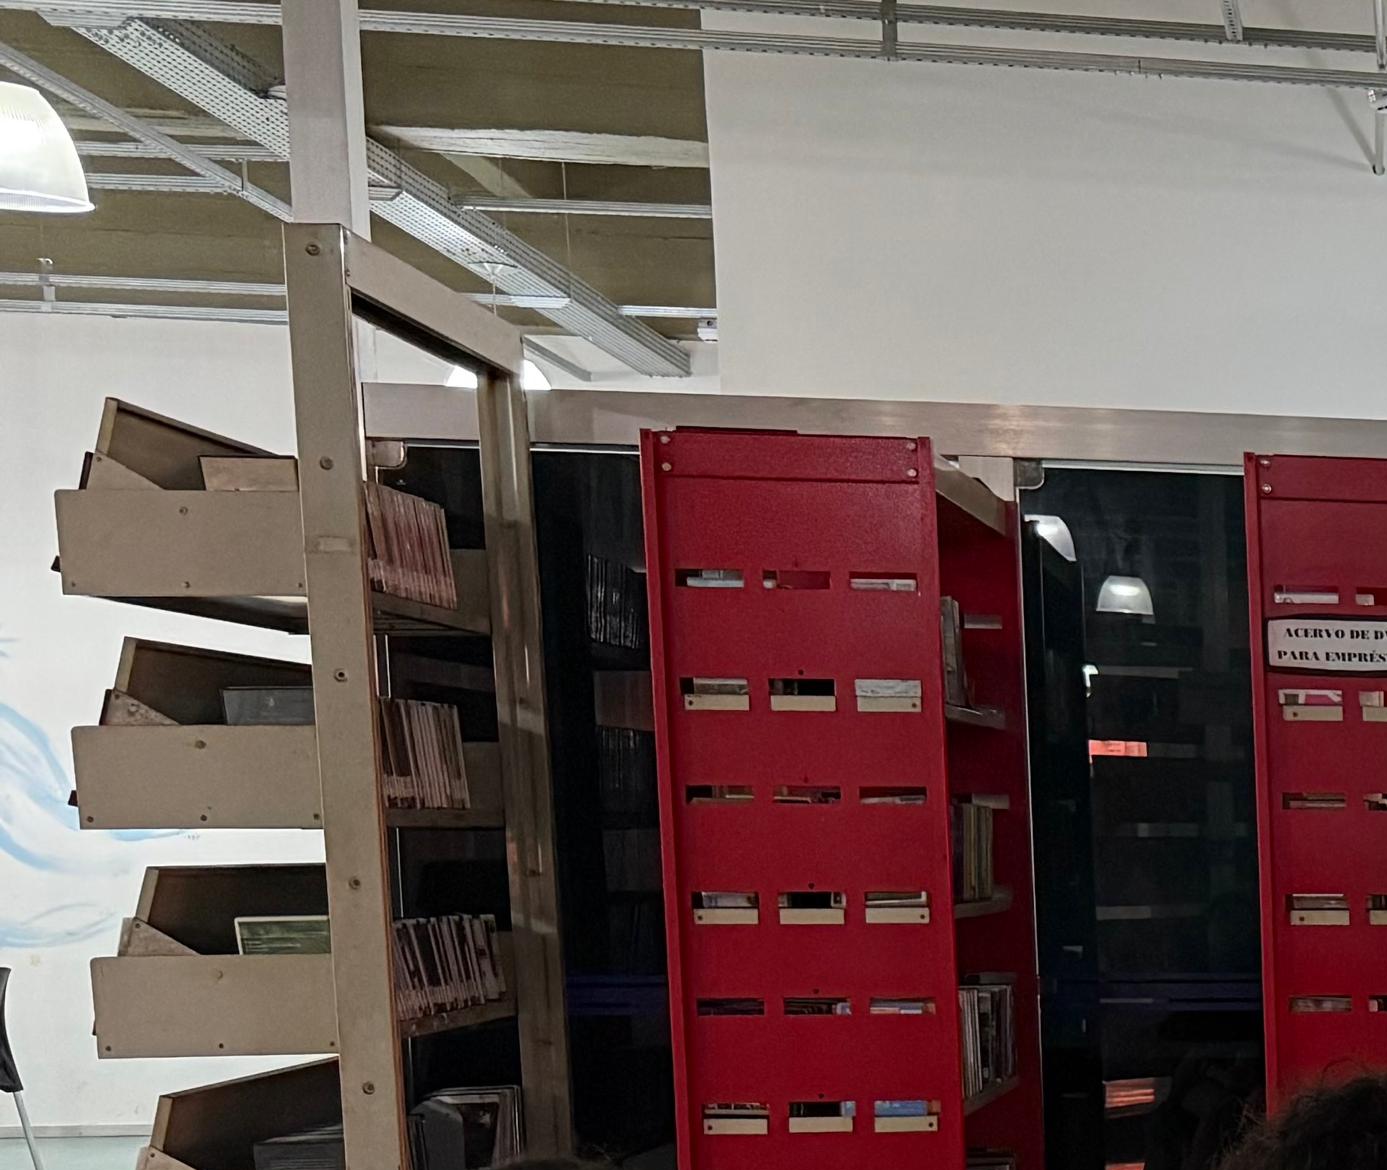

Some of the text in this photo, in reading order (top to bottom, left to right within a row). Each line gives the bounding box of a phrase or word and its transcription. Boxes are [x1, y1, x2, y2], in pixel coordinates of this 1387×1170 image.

[1283, 627, 1345, 640] ACERVO
[1349, 629, 1369, 641] DE
[1277, 649, 1320, 662] PARA
